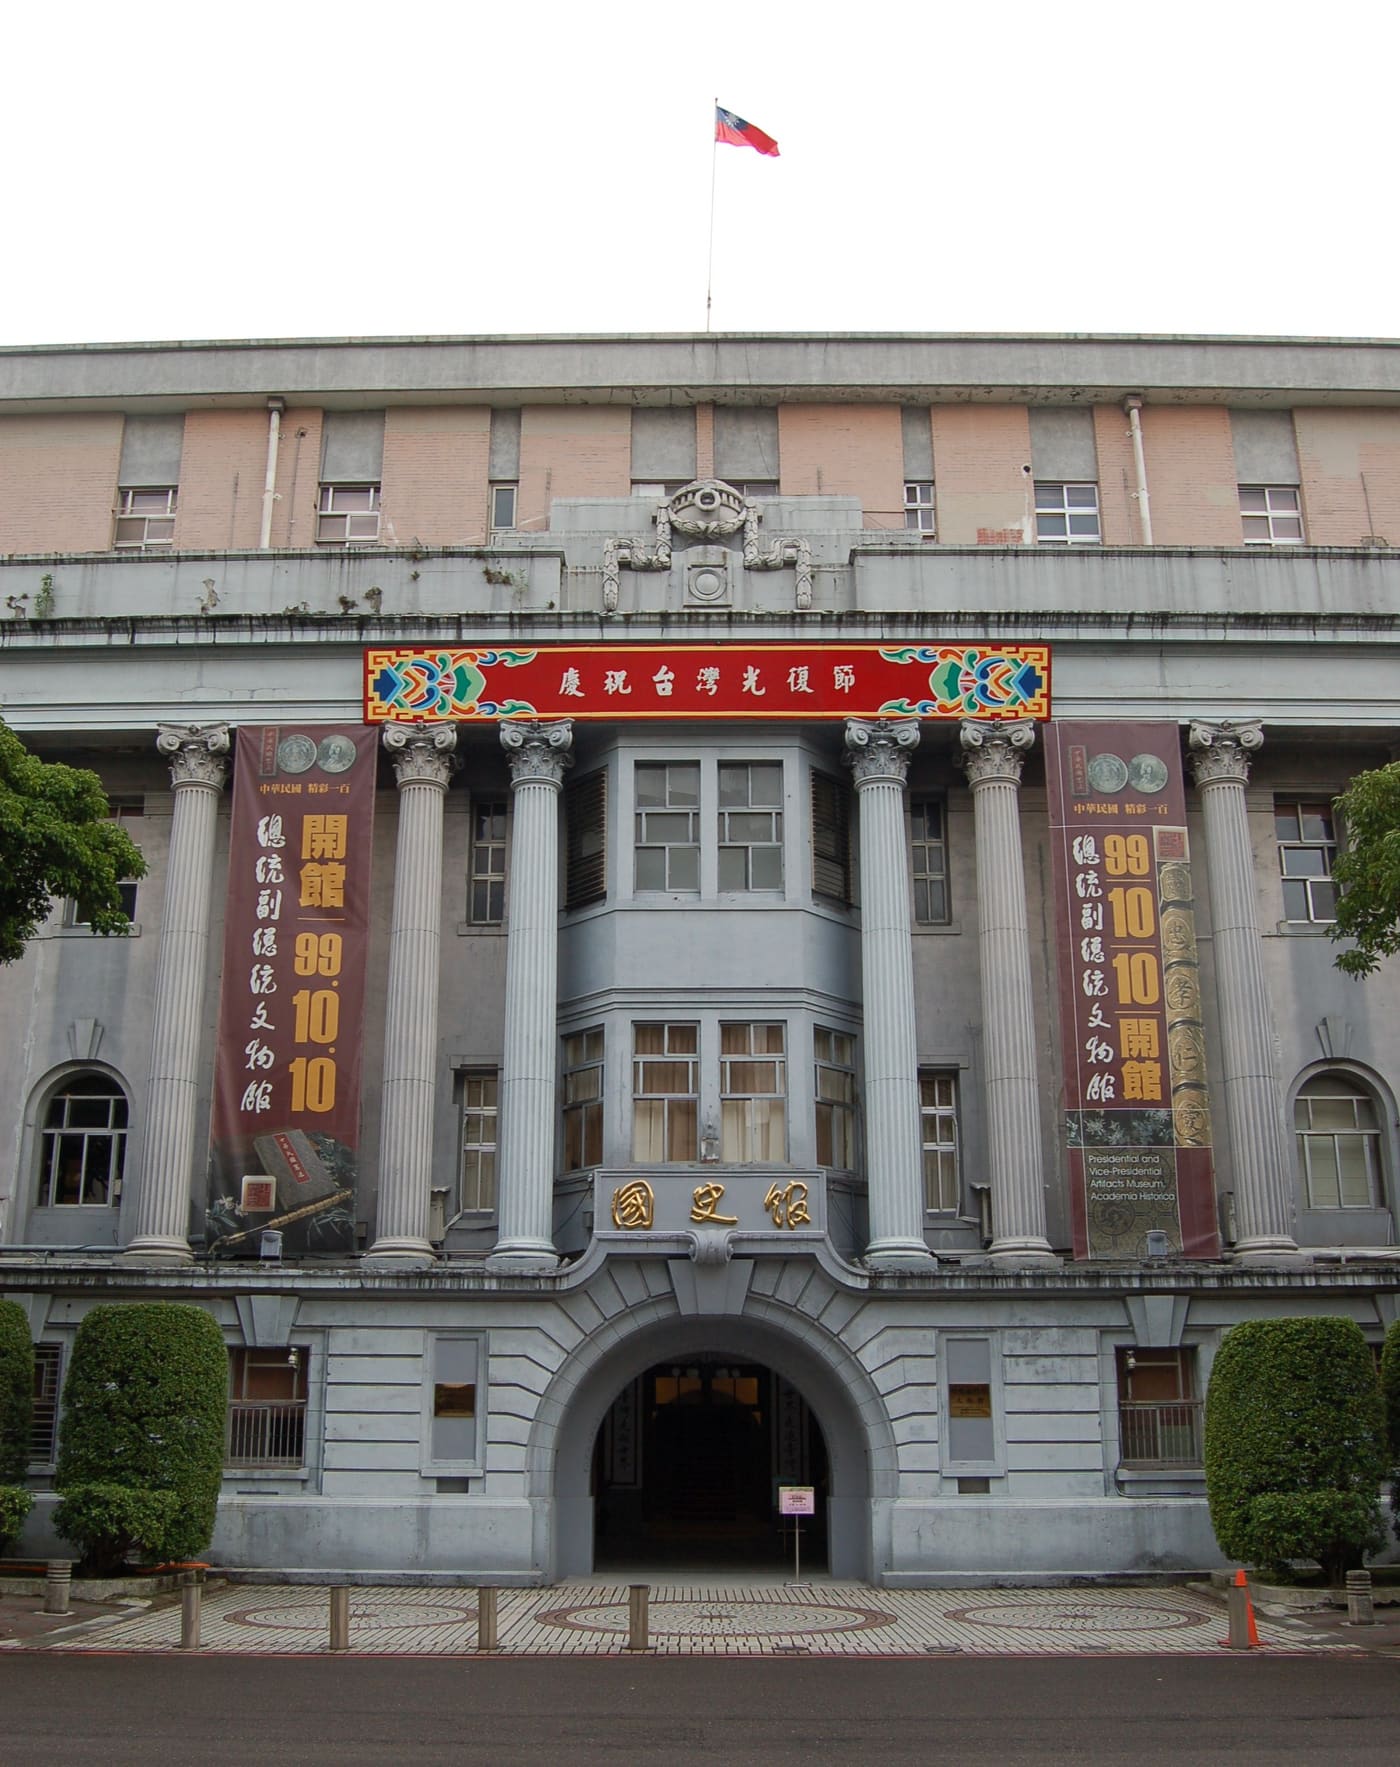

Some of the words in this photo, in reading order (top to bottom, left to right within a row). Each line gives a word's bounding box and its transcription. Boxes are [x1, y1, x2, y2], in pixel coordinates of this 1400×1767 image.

[558, 665, 856, 697] 慶祝台灣光復節
[259, 783, 302, 794] 中華民國
[307, 783, 351, 794] 精彩一百
[1073, 803, 1119, 815] 中華民國
[1124, 803, 1168, 815] 精彩一百
[299, 814, 348, 908] 開館
[1103, 834, 1150, 876] 99
[1107, 887, 1155, 938] 10
[1112, 952, 1160, 1005] 10
[1119, 1018, 1162, 1101] 開館
[1088, 1154, 1140, 1164] Presidential
[1141, 1154, 1160, 1164] and
[1089, 1166, 1162, 1176] Vice-Presidential
[1090, 1179, 1125, 1188] Artifacts
[1090, 1191, 1138, 1201] Academia
[1139, 1191, 1176, 1201] Historica
[612, 1179, 812, 1230] 國史館
